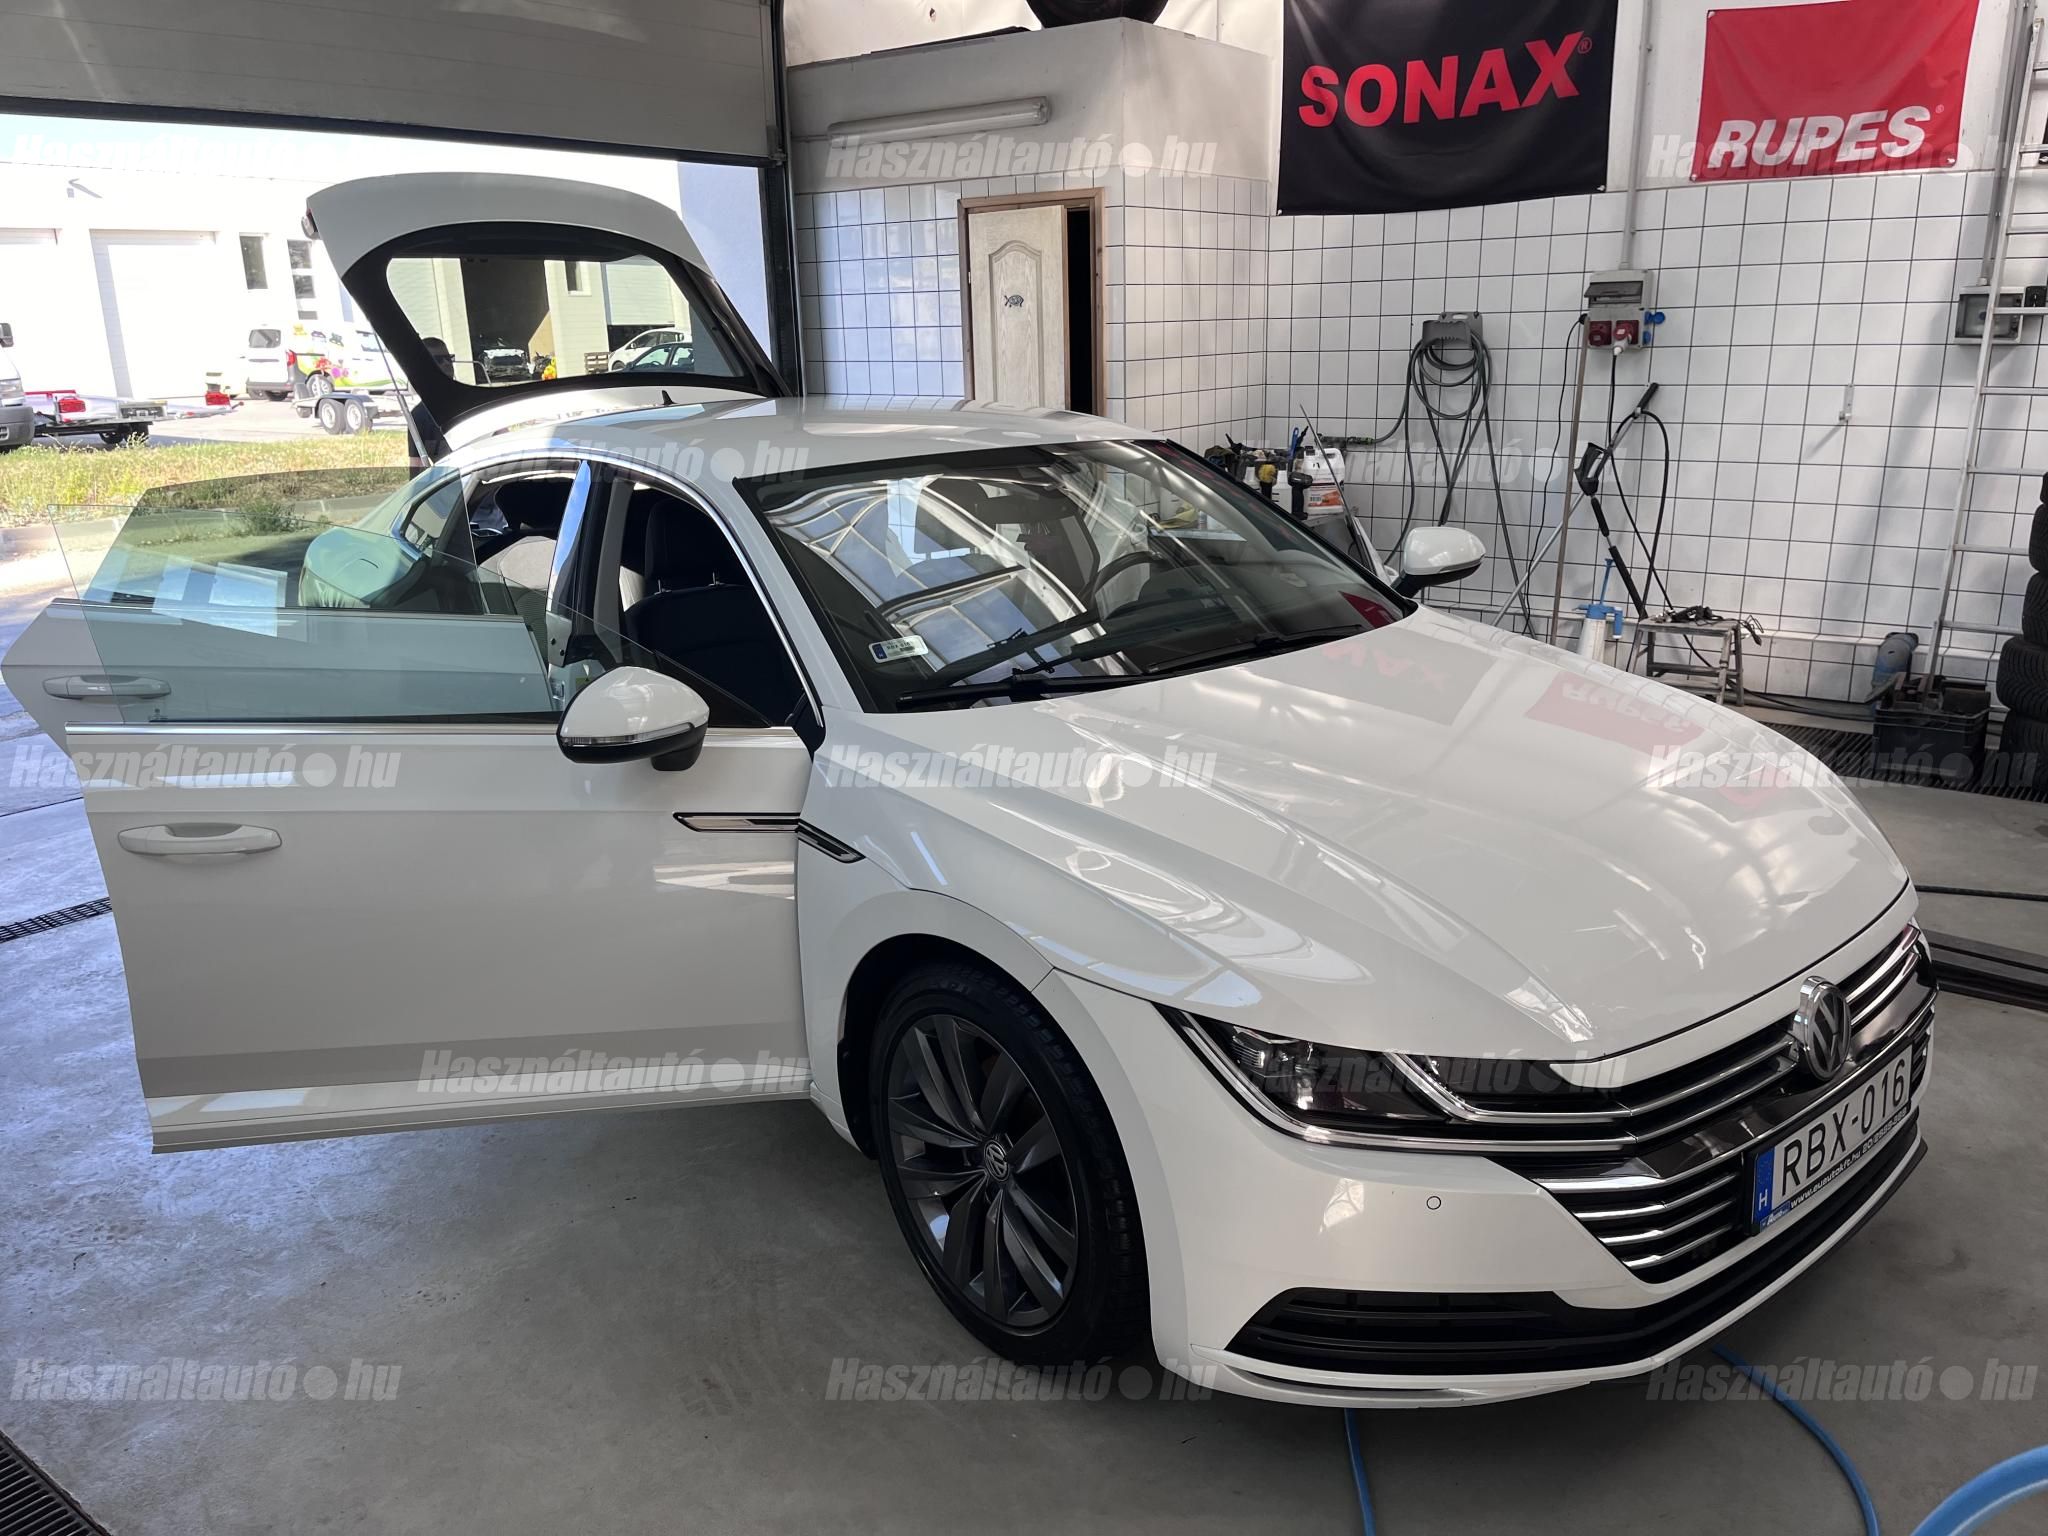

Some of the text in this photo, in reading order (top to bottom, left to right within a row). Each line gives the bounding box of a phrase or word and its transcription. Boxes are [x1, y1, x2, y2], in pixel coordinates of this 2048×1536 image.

[1299, 30, 1584, 128] SONAX
[1707, 105, 1931, 169] RUPES
[1782, 1059, 1906, 1197] RBX-016
[1758, 1188, 1768, 1211] H
